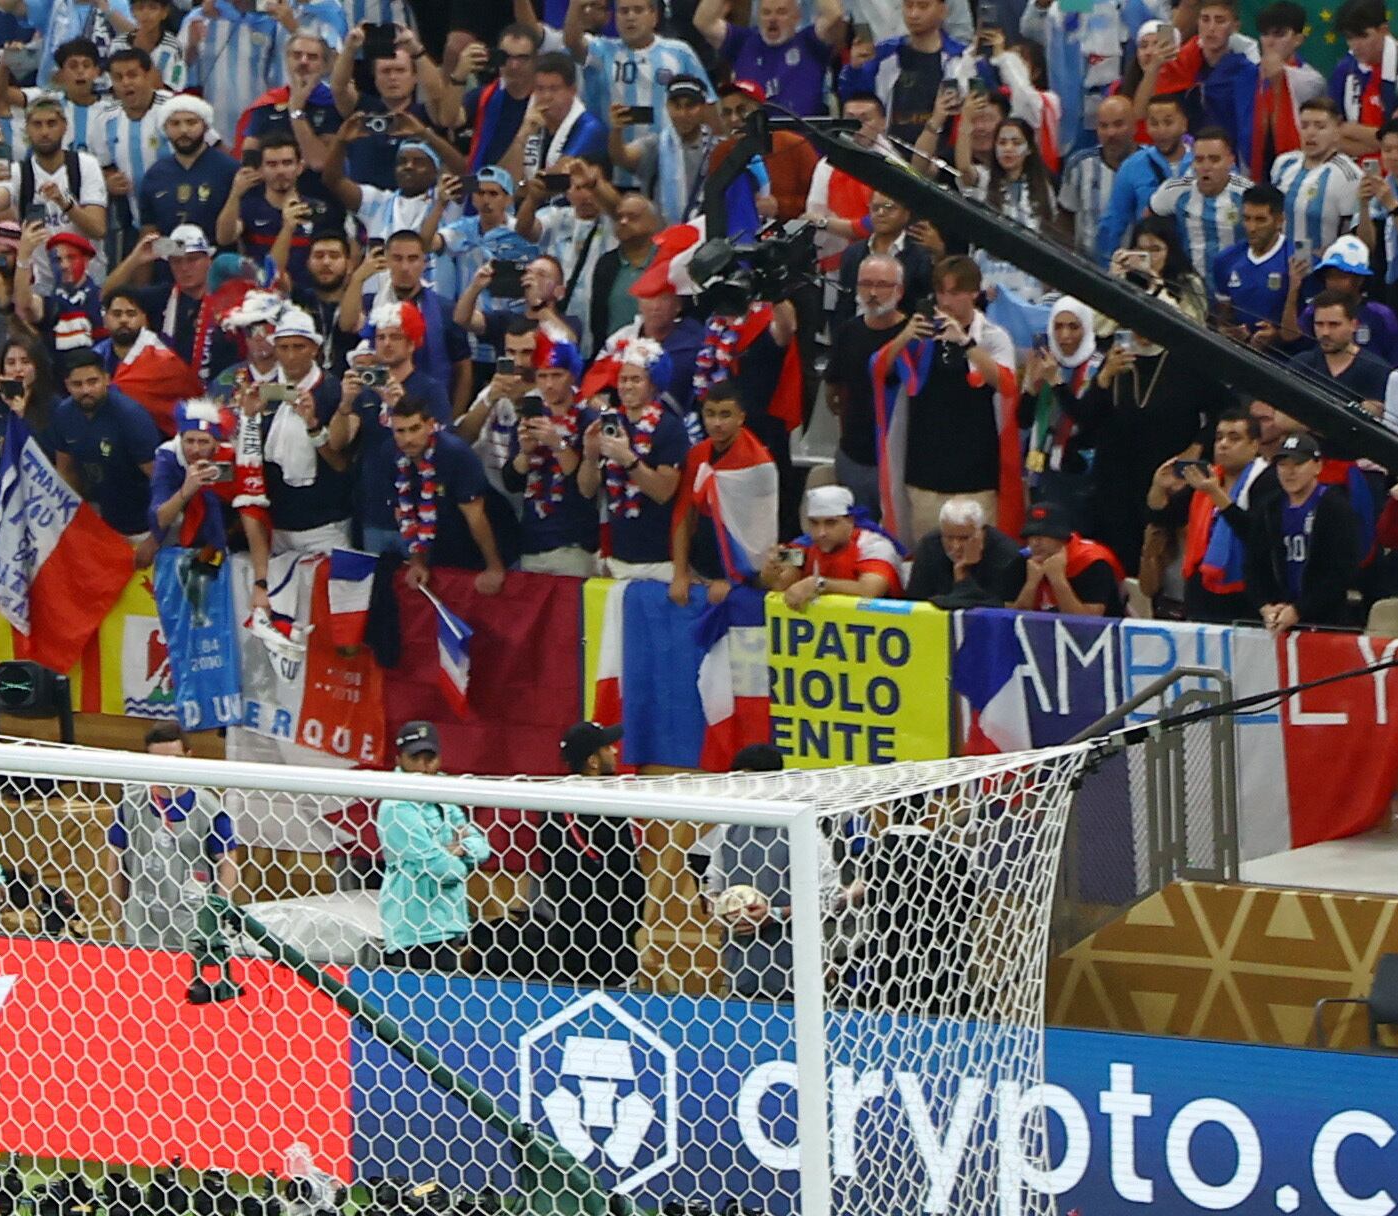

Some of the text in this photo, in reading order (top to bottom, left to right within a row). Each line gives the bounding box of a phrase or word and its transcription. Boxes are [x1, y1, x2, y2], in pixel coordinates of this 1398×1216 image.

[614, 60, 637, 84] 10
[9, 486, 55, 528] YOU
[22, 449, 80, 523] THANK
[1283, 534, 1305, 562] 10
[769, 615, 912, 668] IPATO
[768, 664, 901, 717] RIOLO
[953, 603, 1398, 740] AMBILLY
[183, 693, 375, 762] DUNERQUE
[770, 714, 898, 765] ENTE
